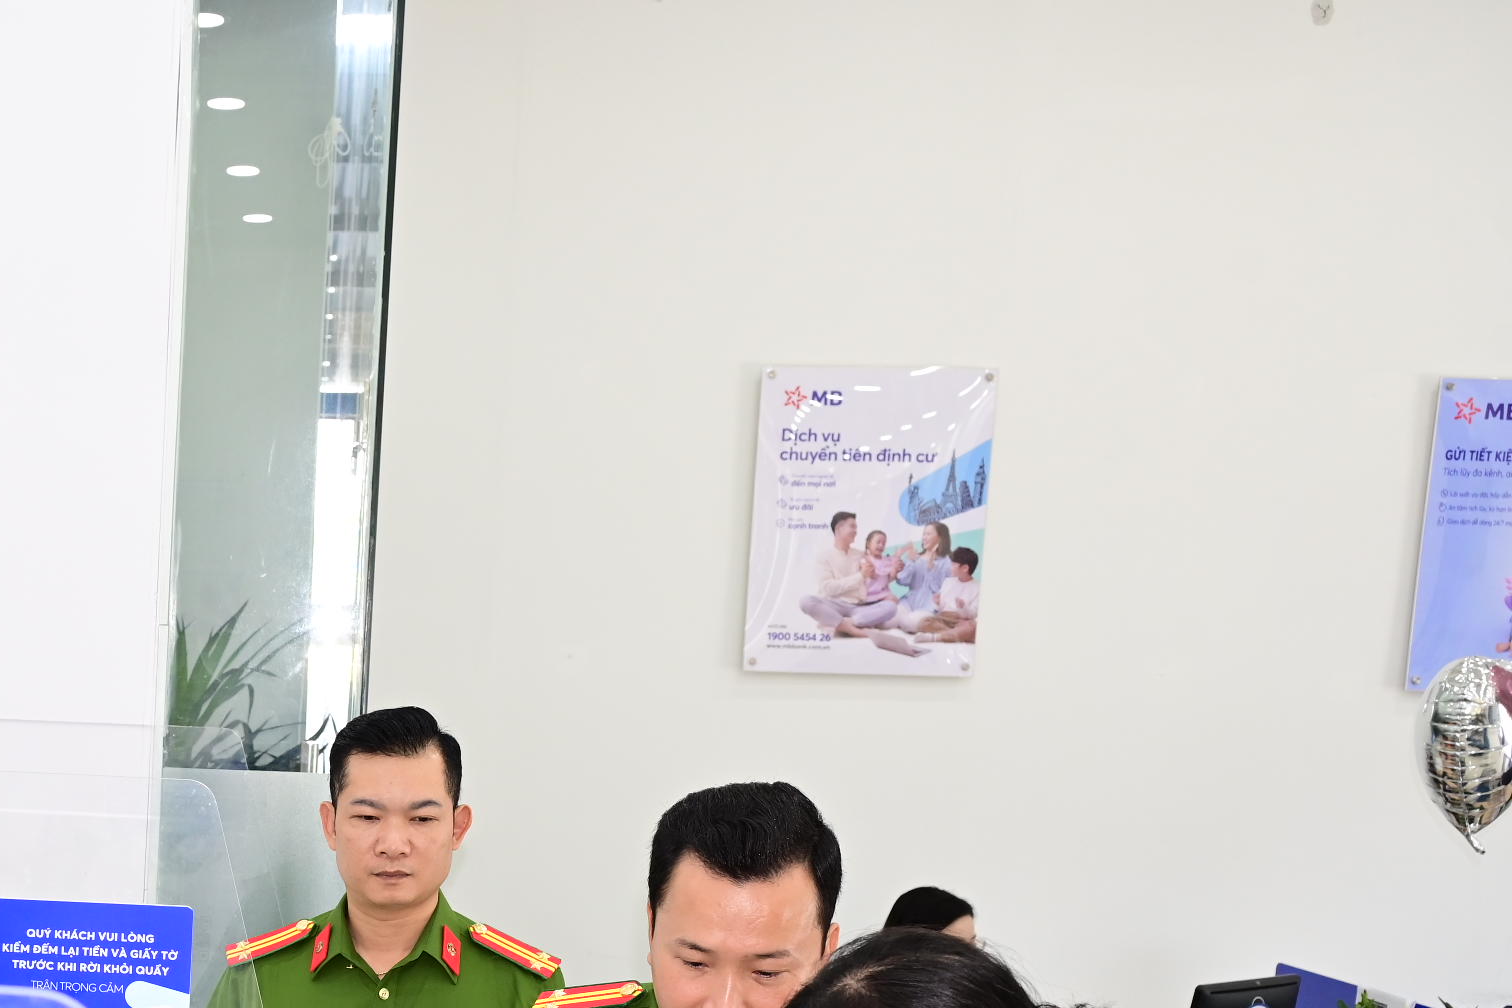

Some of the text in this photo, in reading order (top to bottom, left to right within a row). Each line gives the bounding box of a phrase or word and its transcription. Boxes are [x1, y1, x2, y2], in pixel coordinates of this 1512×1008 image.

[811, 390, 843, 406] MB
[782, 428, 841, 446] Dịch vụ
[780, 445, 838, 464] chuyển
[876, 448, 911, 467] định
[916, 452, 938, 463] cư
[1445, 446, 1466, 461] GỬI
[1469, 447, 1493, 462] TIẾT
[768, 631, 791, 641] 1900
[793, 631, 817, 641] 5454
[26, 927, 155, 943] QUÝ KHÁCH VUI LÒNG
[2, 940, 179, 961] KIỂM ĐẾM LẠI TIỀN VÀ GIẤY TỜ
[12, 958, 54, 971] TRƯỚC
[57, 961, 77, 972] KHI
[79, 960, 101, 973] RỜI
[103, 961, 133, 974] KHỎI
[30, 979, 124, 994] TRÂN TRỌNG CẢM
